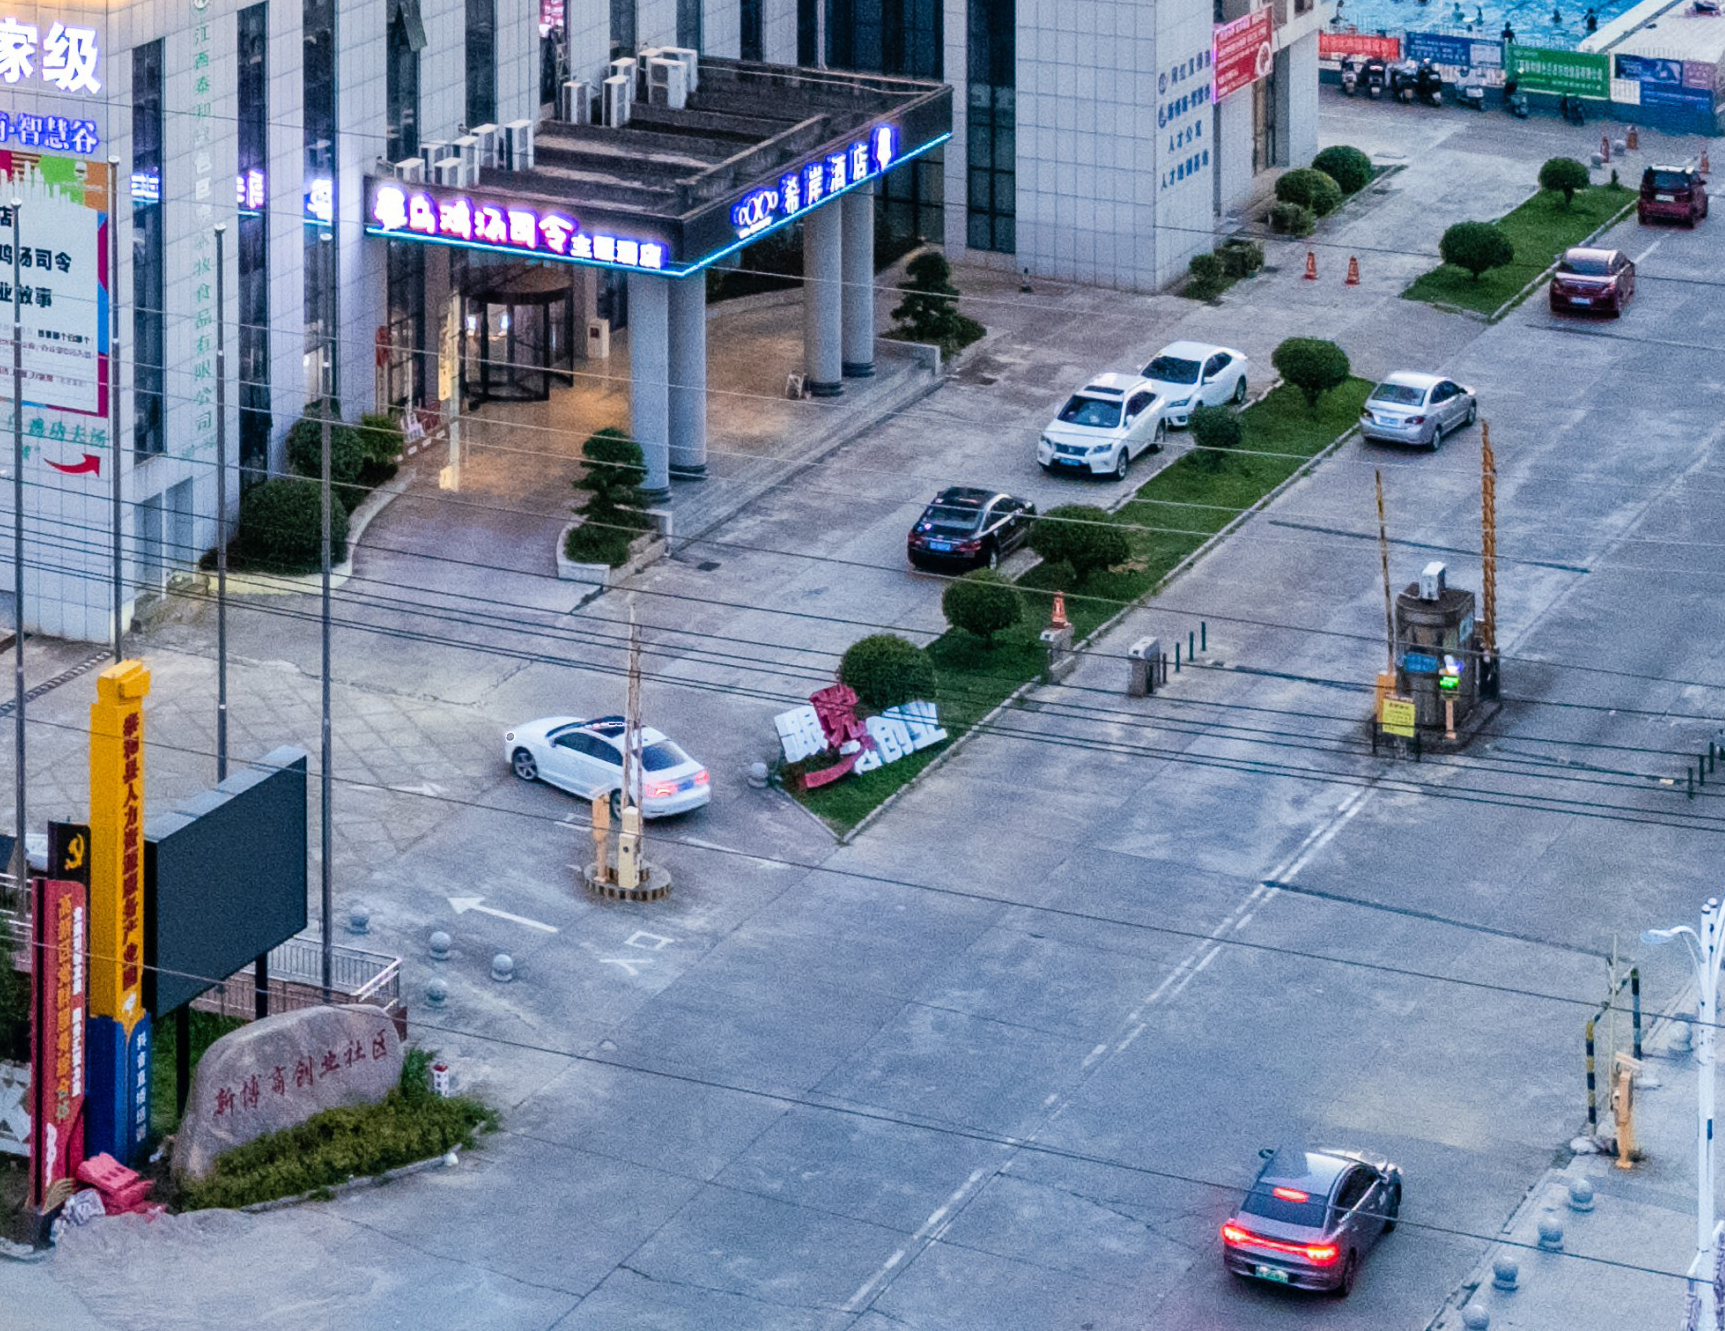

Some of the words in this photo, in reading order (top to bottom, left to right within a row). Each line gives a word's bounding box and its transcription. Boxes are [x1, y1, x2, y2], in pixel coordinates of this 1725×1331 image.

[410, 194, 576, 255] 乌鸡汤司令
[570, 232, 663, 269] 主题酒店
